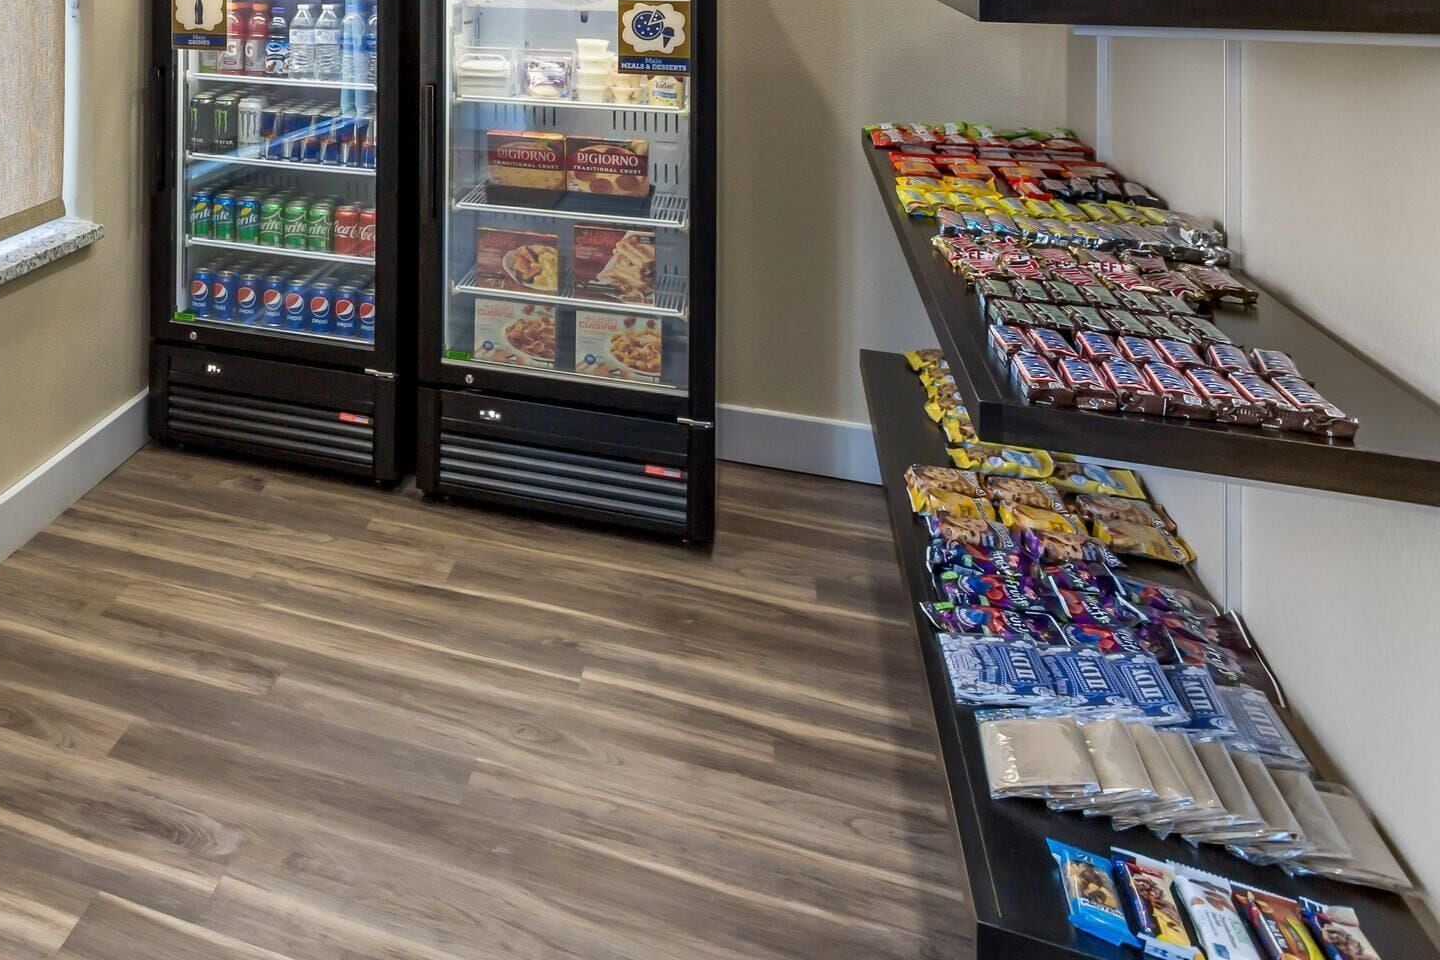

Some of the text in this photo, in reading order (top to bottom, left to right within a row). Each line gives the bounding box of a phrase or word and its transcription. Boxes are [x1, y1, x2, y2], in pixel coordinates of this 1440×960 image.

[621, 62, 644, 70] MEALS
[651, 63, 687, 72] DESSERTS
[577, 152, 639, 167] DIGIORNO
[573, 164, 617, 173] TRADITIONAL
